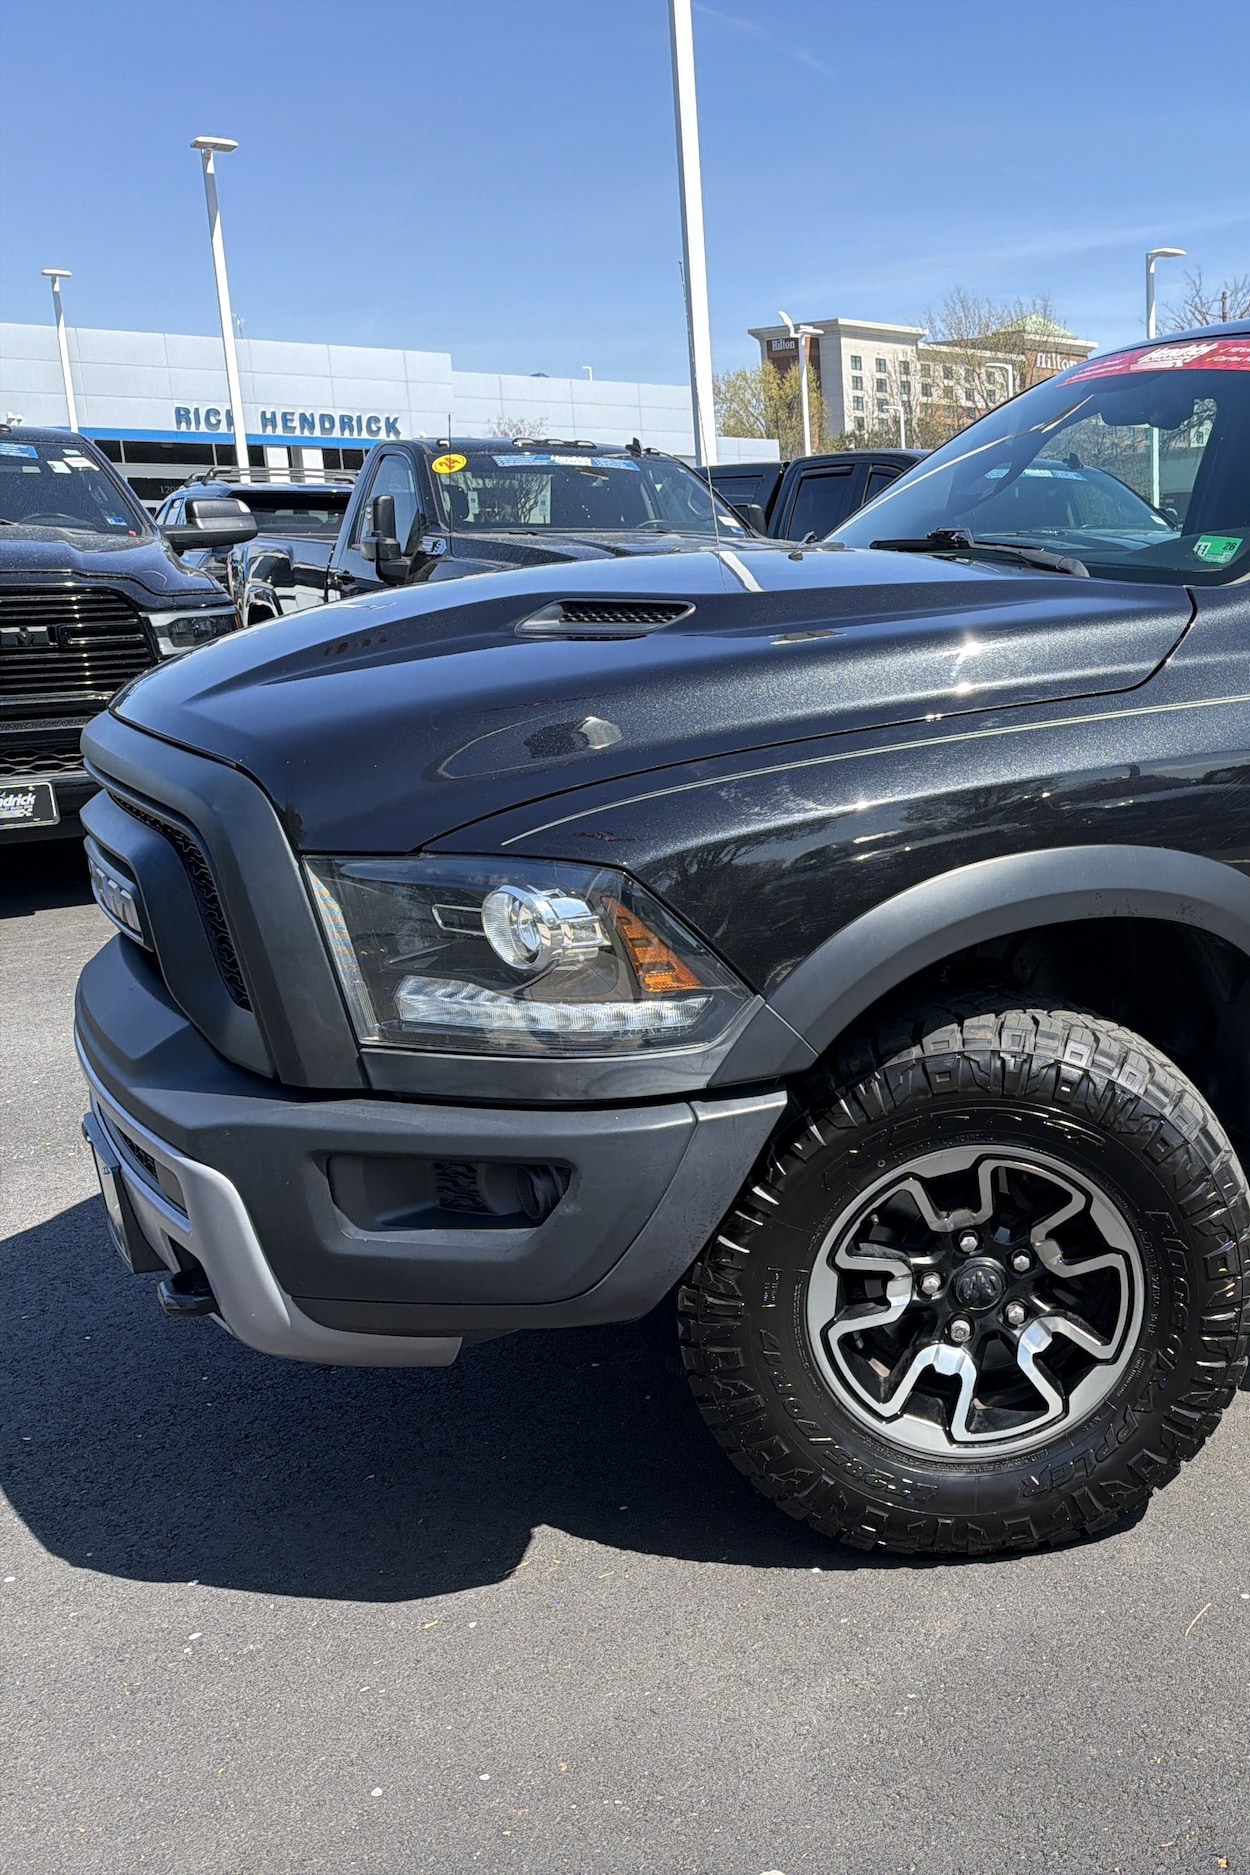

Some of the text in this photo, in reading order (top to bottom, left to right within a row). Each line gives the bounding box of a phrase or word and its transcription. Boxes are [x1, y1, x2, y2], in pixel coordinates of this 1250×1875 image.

[772, 340, 796, 351] Hilton
[260, 410, 401, 439] HENDRICK
[1195, 544, 1209, 555] 11
